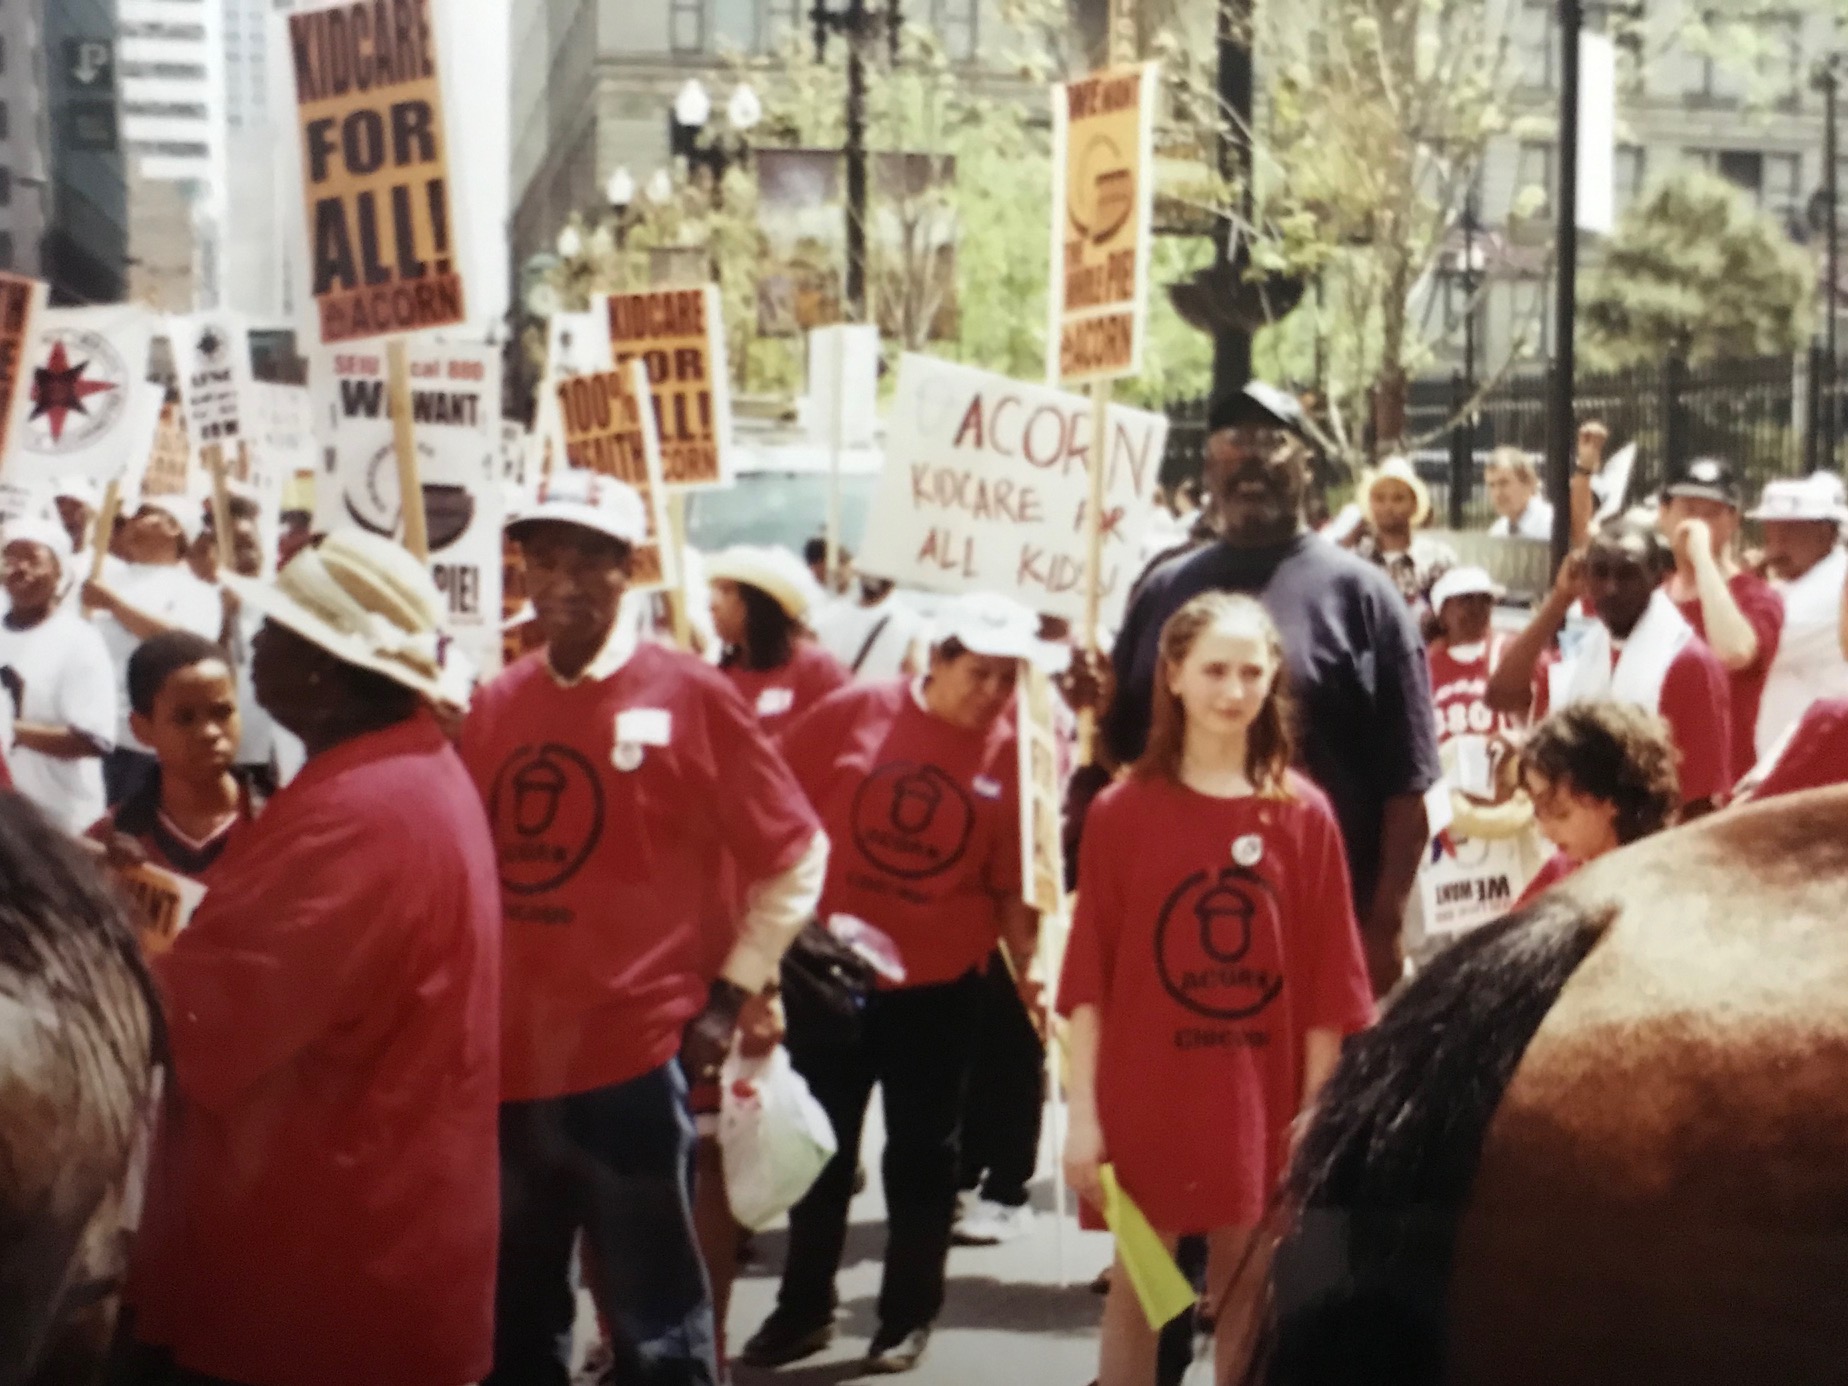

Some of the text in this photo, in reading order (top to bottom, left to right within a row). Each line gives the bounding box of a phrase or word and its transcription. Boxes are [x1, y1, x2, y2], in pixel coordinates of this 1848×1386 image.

[305, 98, 437, 184] FOR
[312, 178, 450, 297] ALL!
[410, 389, 480, 427] WANT
[650, 391, 713, 441] LL!
[910, 462, 1044, 523] KIDCARE
[916, 526, 979, 579] ALL
